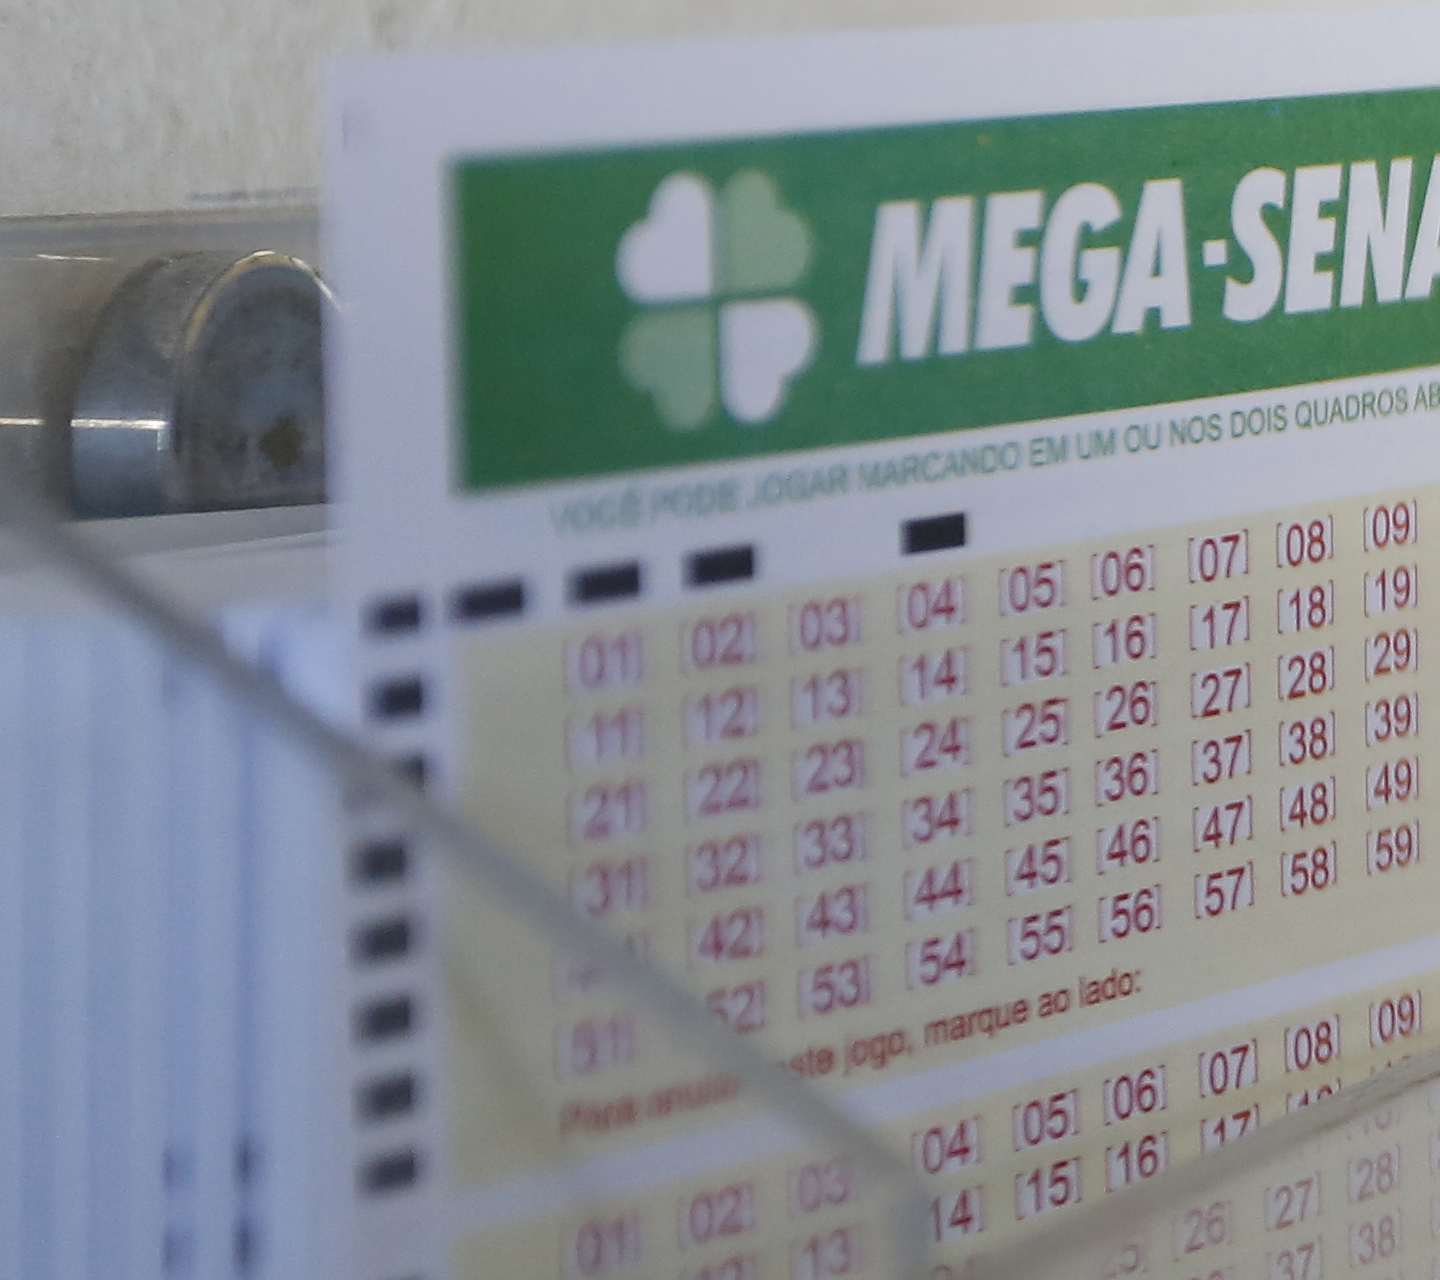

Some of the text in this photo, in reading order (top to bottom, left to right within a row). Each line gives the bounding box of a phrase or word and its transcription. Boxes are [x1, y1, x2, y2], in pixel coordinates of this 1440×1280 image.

[652, 477, 738, 519] PODE
[746, 463, 847, 509] JOGAR
[859, 441, 1019, 492] MARCANDO
[1029, 436, 1068, 467] EM
[1075, 430, 1116, 461] UM
[1123, 424, 1160, 453] OU
[1169, 414, 1222, 447] NOS
[1231, 402, 1288, 439] DOIS
[1294, 387, 1407, 429] QUADROS
[844, 1028, 915, 1076] jogo,
[924, 998, 1030, 1047] marque
[1038, 988, 1071, 1019] ao
[1079, 968, 1142, 1008] lado:
